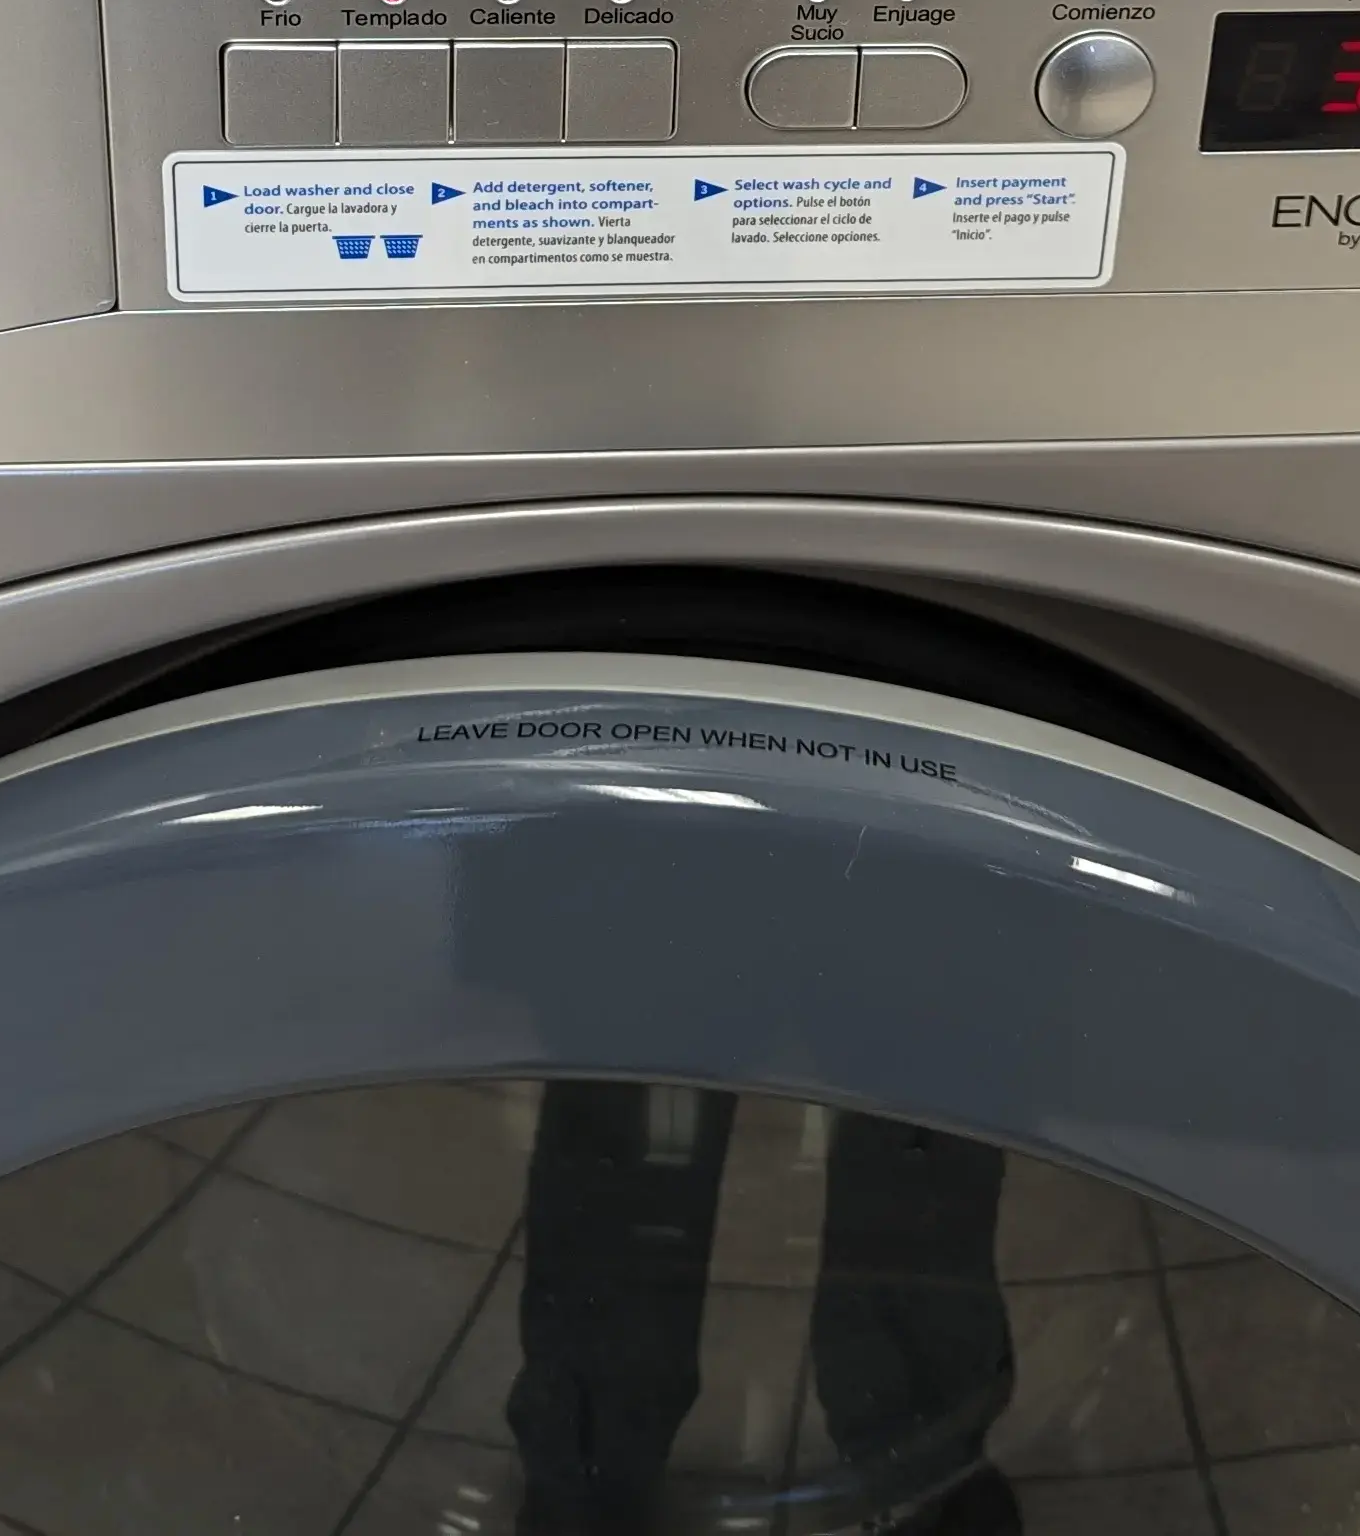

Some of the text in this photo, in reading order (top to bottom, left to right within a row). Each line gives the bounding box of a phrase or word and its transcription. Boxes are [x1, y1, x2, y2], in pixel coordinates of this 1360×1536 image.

[260, 10, 301, 27] Frio
[341, 9, 448, 29] Templado
[469, 8, 556, 25] Caliente
[584, 7, 674, 25] Delicado
[796, 4, 838, 24] Muy
[873, 5, 956, 26] Enjuage
[1051, 4, 1156, 21] Comienzo
[790, 24, 844, 41] Sucio
[244, 183, 415, 197] Load washer and close
[472, 180, 653, 195] Add detergent, softener,
[734, 177, 892, 192] Select wash cycle and
[956, 177, 1066, 190] Insert payment
[472, 198, 659, 212] and bleach into compart-
[733, 196, 871, 210] options. Pulse el botón
[954, 194, 982, 206] and
[985, 195, 1024, 207] press
[244, 203, 284, 215] door.
[286, 203, 326, 217] Cargue
[328, 202, 338, 214] la
[341, 202, 389, 214] lavadora
[472, 216, 631, 229] ments as shown. Vierta
[732, 213, 872, 228] para seleccionar el ciclo de
[952, 212, 989, 223] Inserte
[992, 211, 1002, 222] el
[1004, 213, 1031, 225] pago
[1041, 211, 1070, 224] pulse
[244, 221, 332, 235] cierre la puerta.
[472, 235, 535, 249] detergente,
[538, 234, 596, 247] suavizante
[607, 233, 675, 247] blanqueador
[731, 231, 880, 245] lavado. Seleccione opciones.
[1338, 230, 1360, 249] by
[472, 251, 673, 266] en compartimentos como se muestra.
[417, 721, 957, 782] LEAVE DOOR OPEN WHEN NOT IN USE
